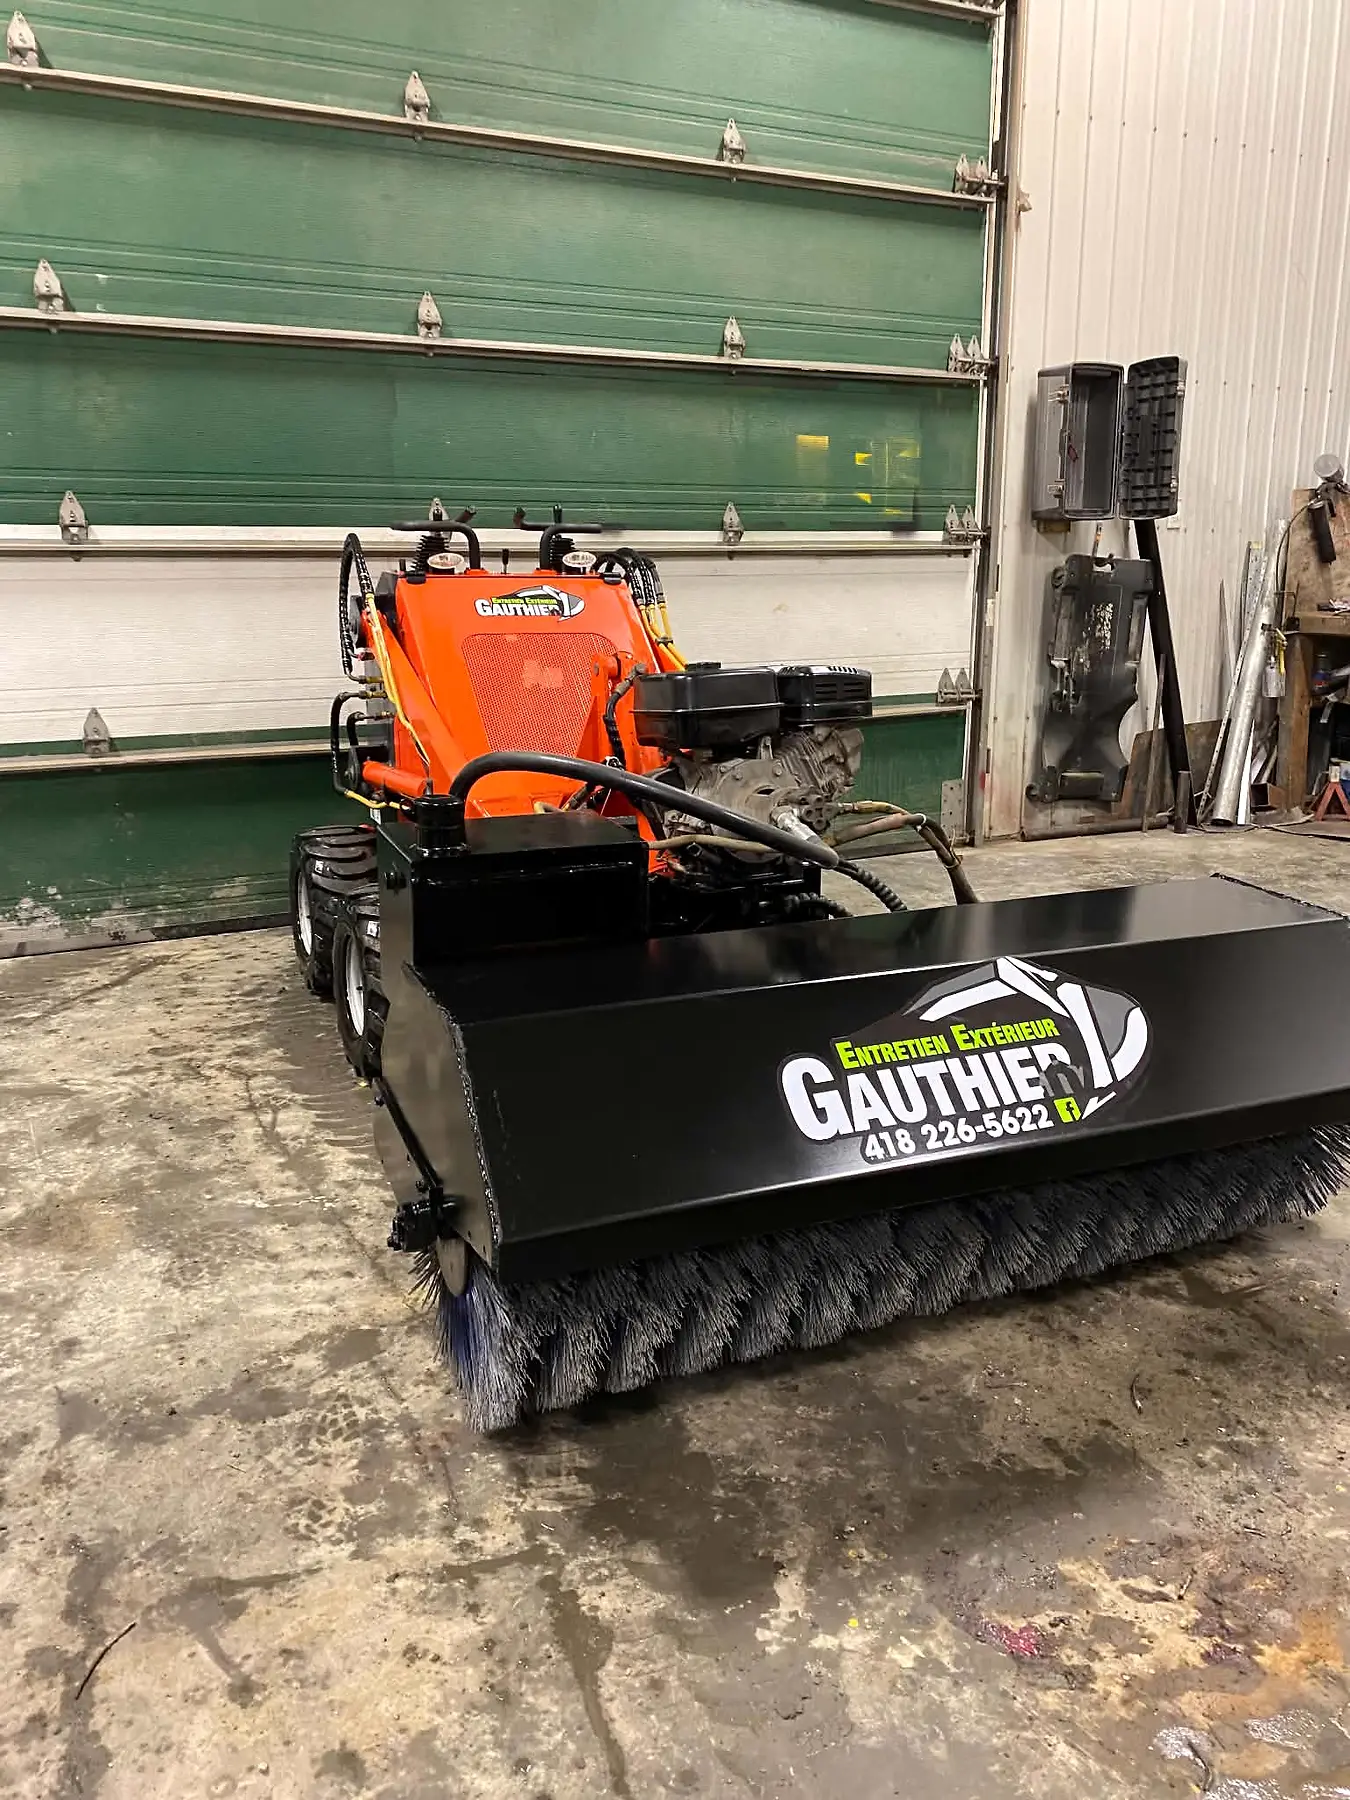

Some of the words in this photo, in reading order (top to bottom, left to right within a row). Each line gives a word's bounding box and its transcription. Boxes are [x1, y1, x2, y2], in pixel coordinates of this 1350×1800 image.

[835, 1034, 950, 1069] ENTRETIEN
[950, 1018, 1060, 1050] EXTÉRIEUR
[864, 1128, 916, 1161] 418
[921, 1103, 1054, 1151] 226-5622
